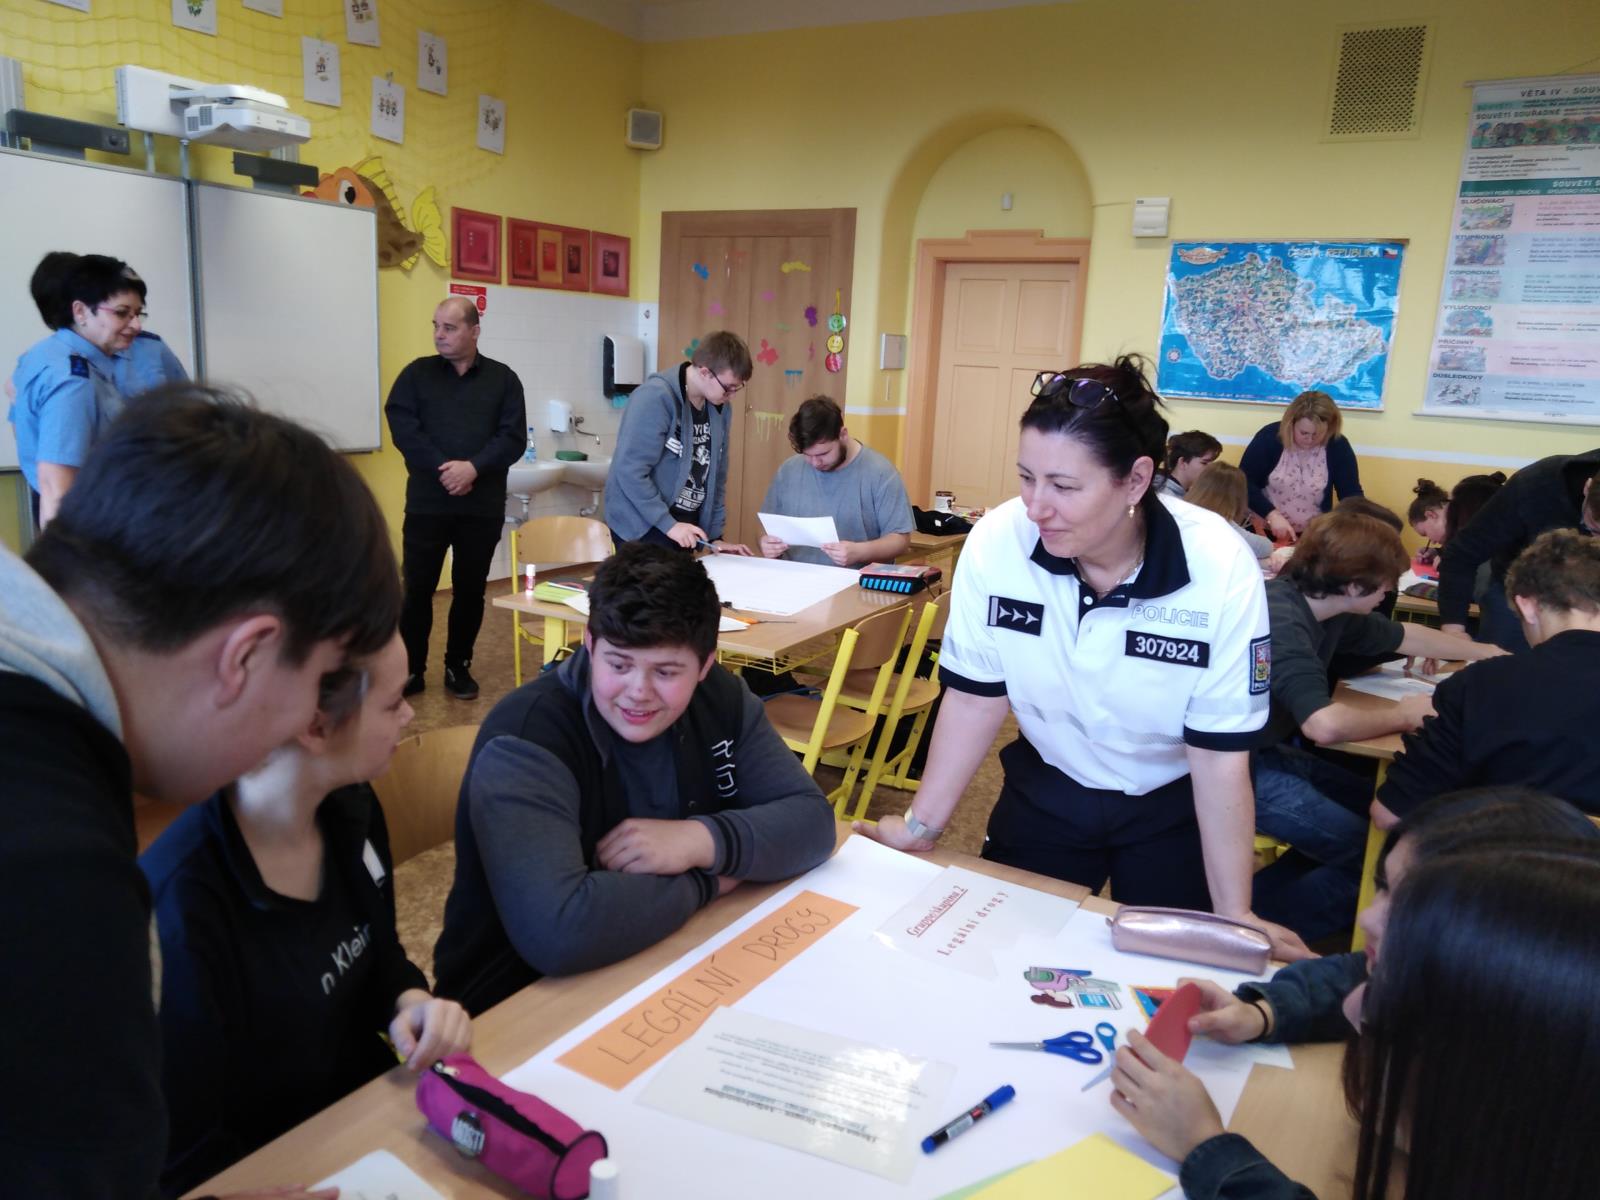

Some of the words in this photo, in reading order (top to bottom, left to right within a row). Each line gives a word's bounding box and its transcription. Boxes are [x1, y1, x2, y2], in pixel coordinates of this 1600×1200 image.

[1131, 605, 1209, 629] POLICIE
[1135, 635, 1200, 663] 307924
[975, 891, 1009, 918] drogy
[597, 953, 742, 1065] LEGÁLNÍ
[742, 907, 831, 961] DROGY
